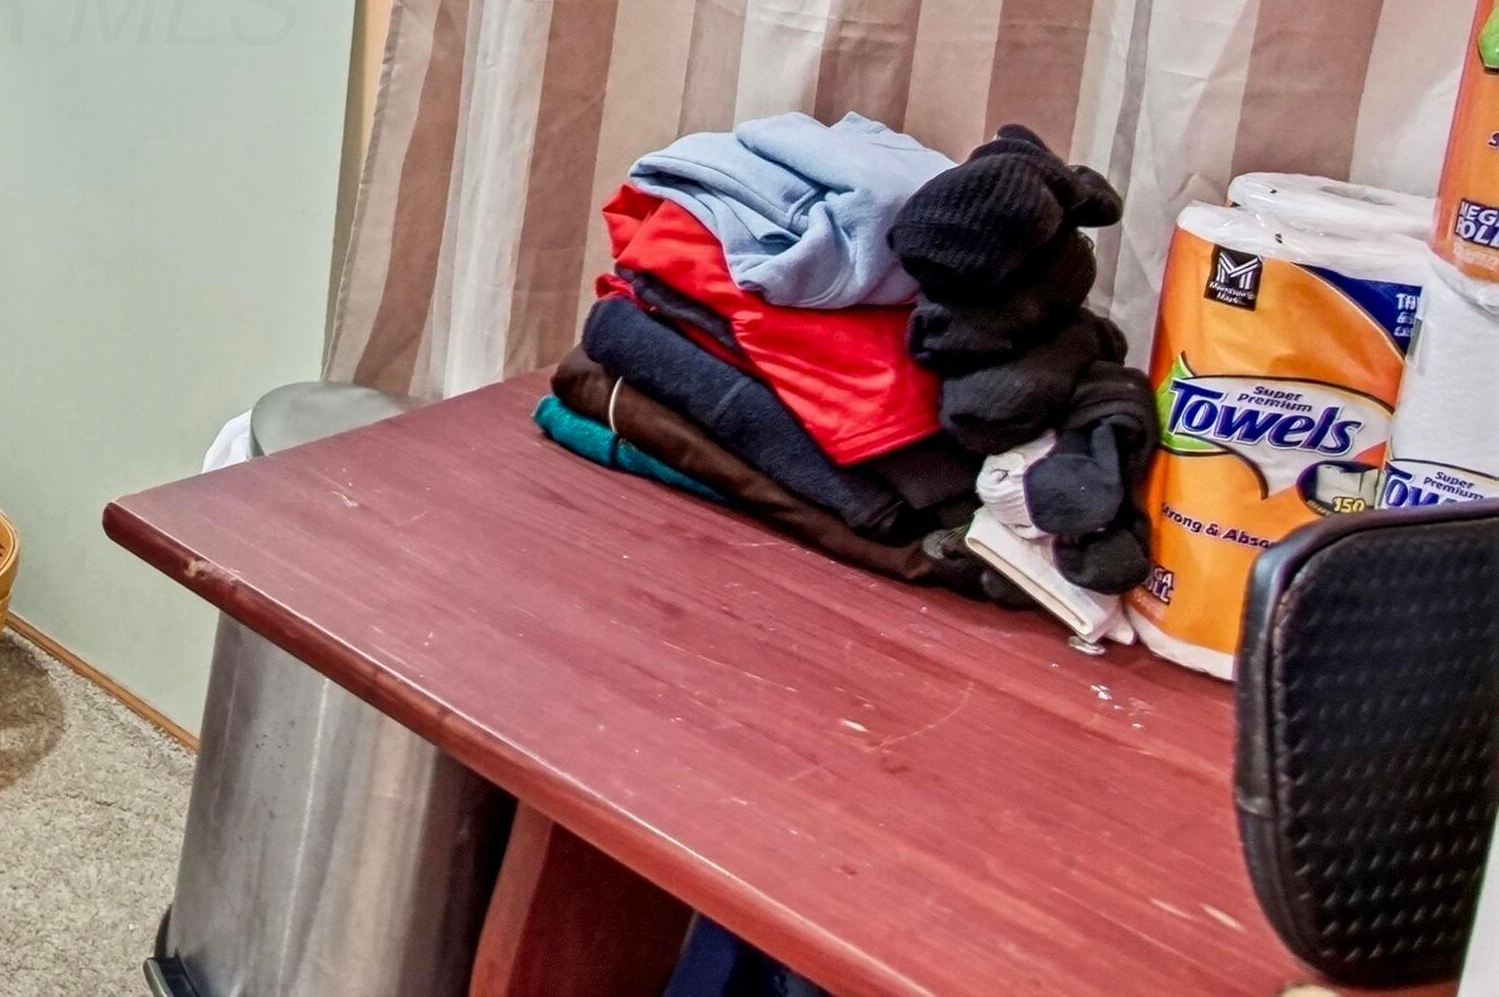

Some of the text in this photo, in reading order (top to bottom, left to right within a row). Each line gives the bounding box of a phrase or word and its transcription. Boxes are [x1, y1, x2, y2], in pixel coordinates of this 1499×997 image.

[1237, 392, 1313, 412] Premium
[1253, 385, 1303, 401] Super
[1166, 379, 1366, 455] Towels
[1435, 470, 1475, 489] Super
[1205, 522, 1220, 537] &
